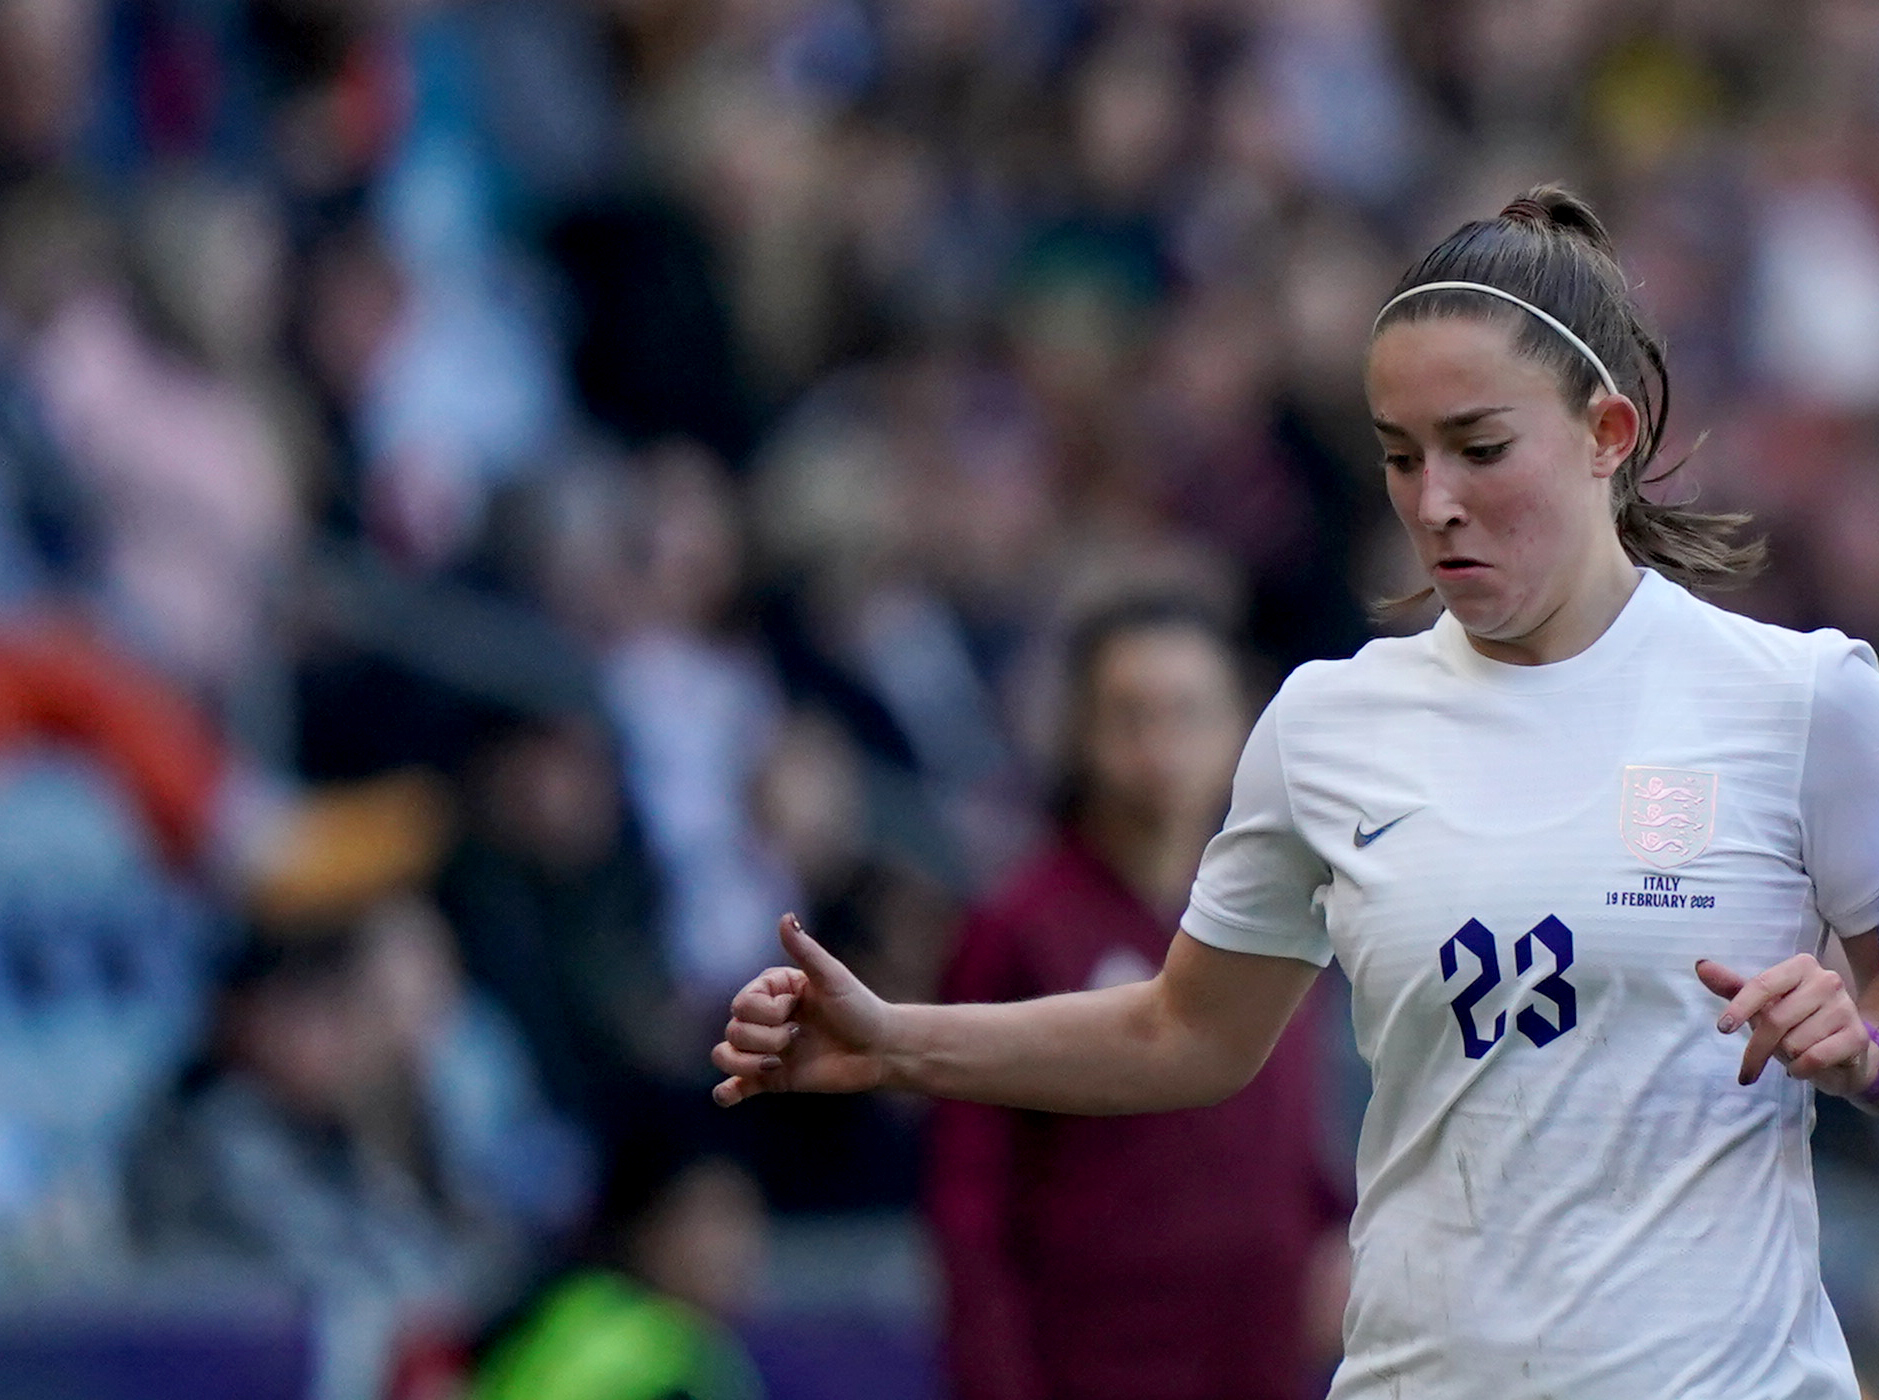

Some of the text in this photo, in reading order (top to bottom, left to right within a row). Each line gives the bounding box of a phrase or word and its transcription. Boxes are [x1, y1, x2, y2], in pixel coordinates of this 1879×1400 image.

[1644, 876, 1681, 891] ITALY
[1605, 891, 1715, 909] 19 FEBRUARY 2023
[1439, 913, 1577, 1060] 23
